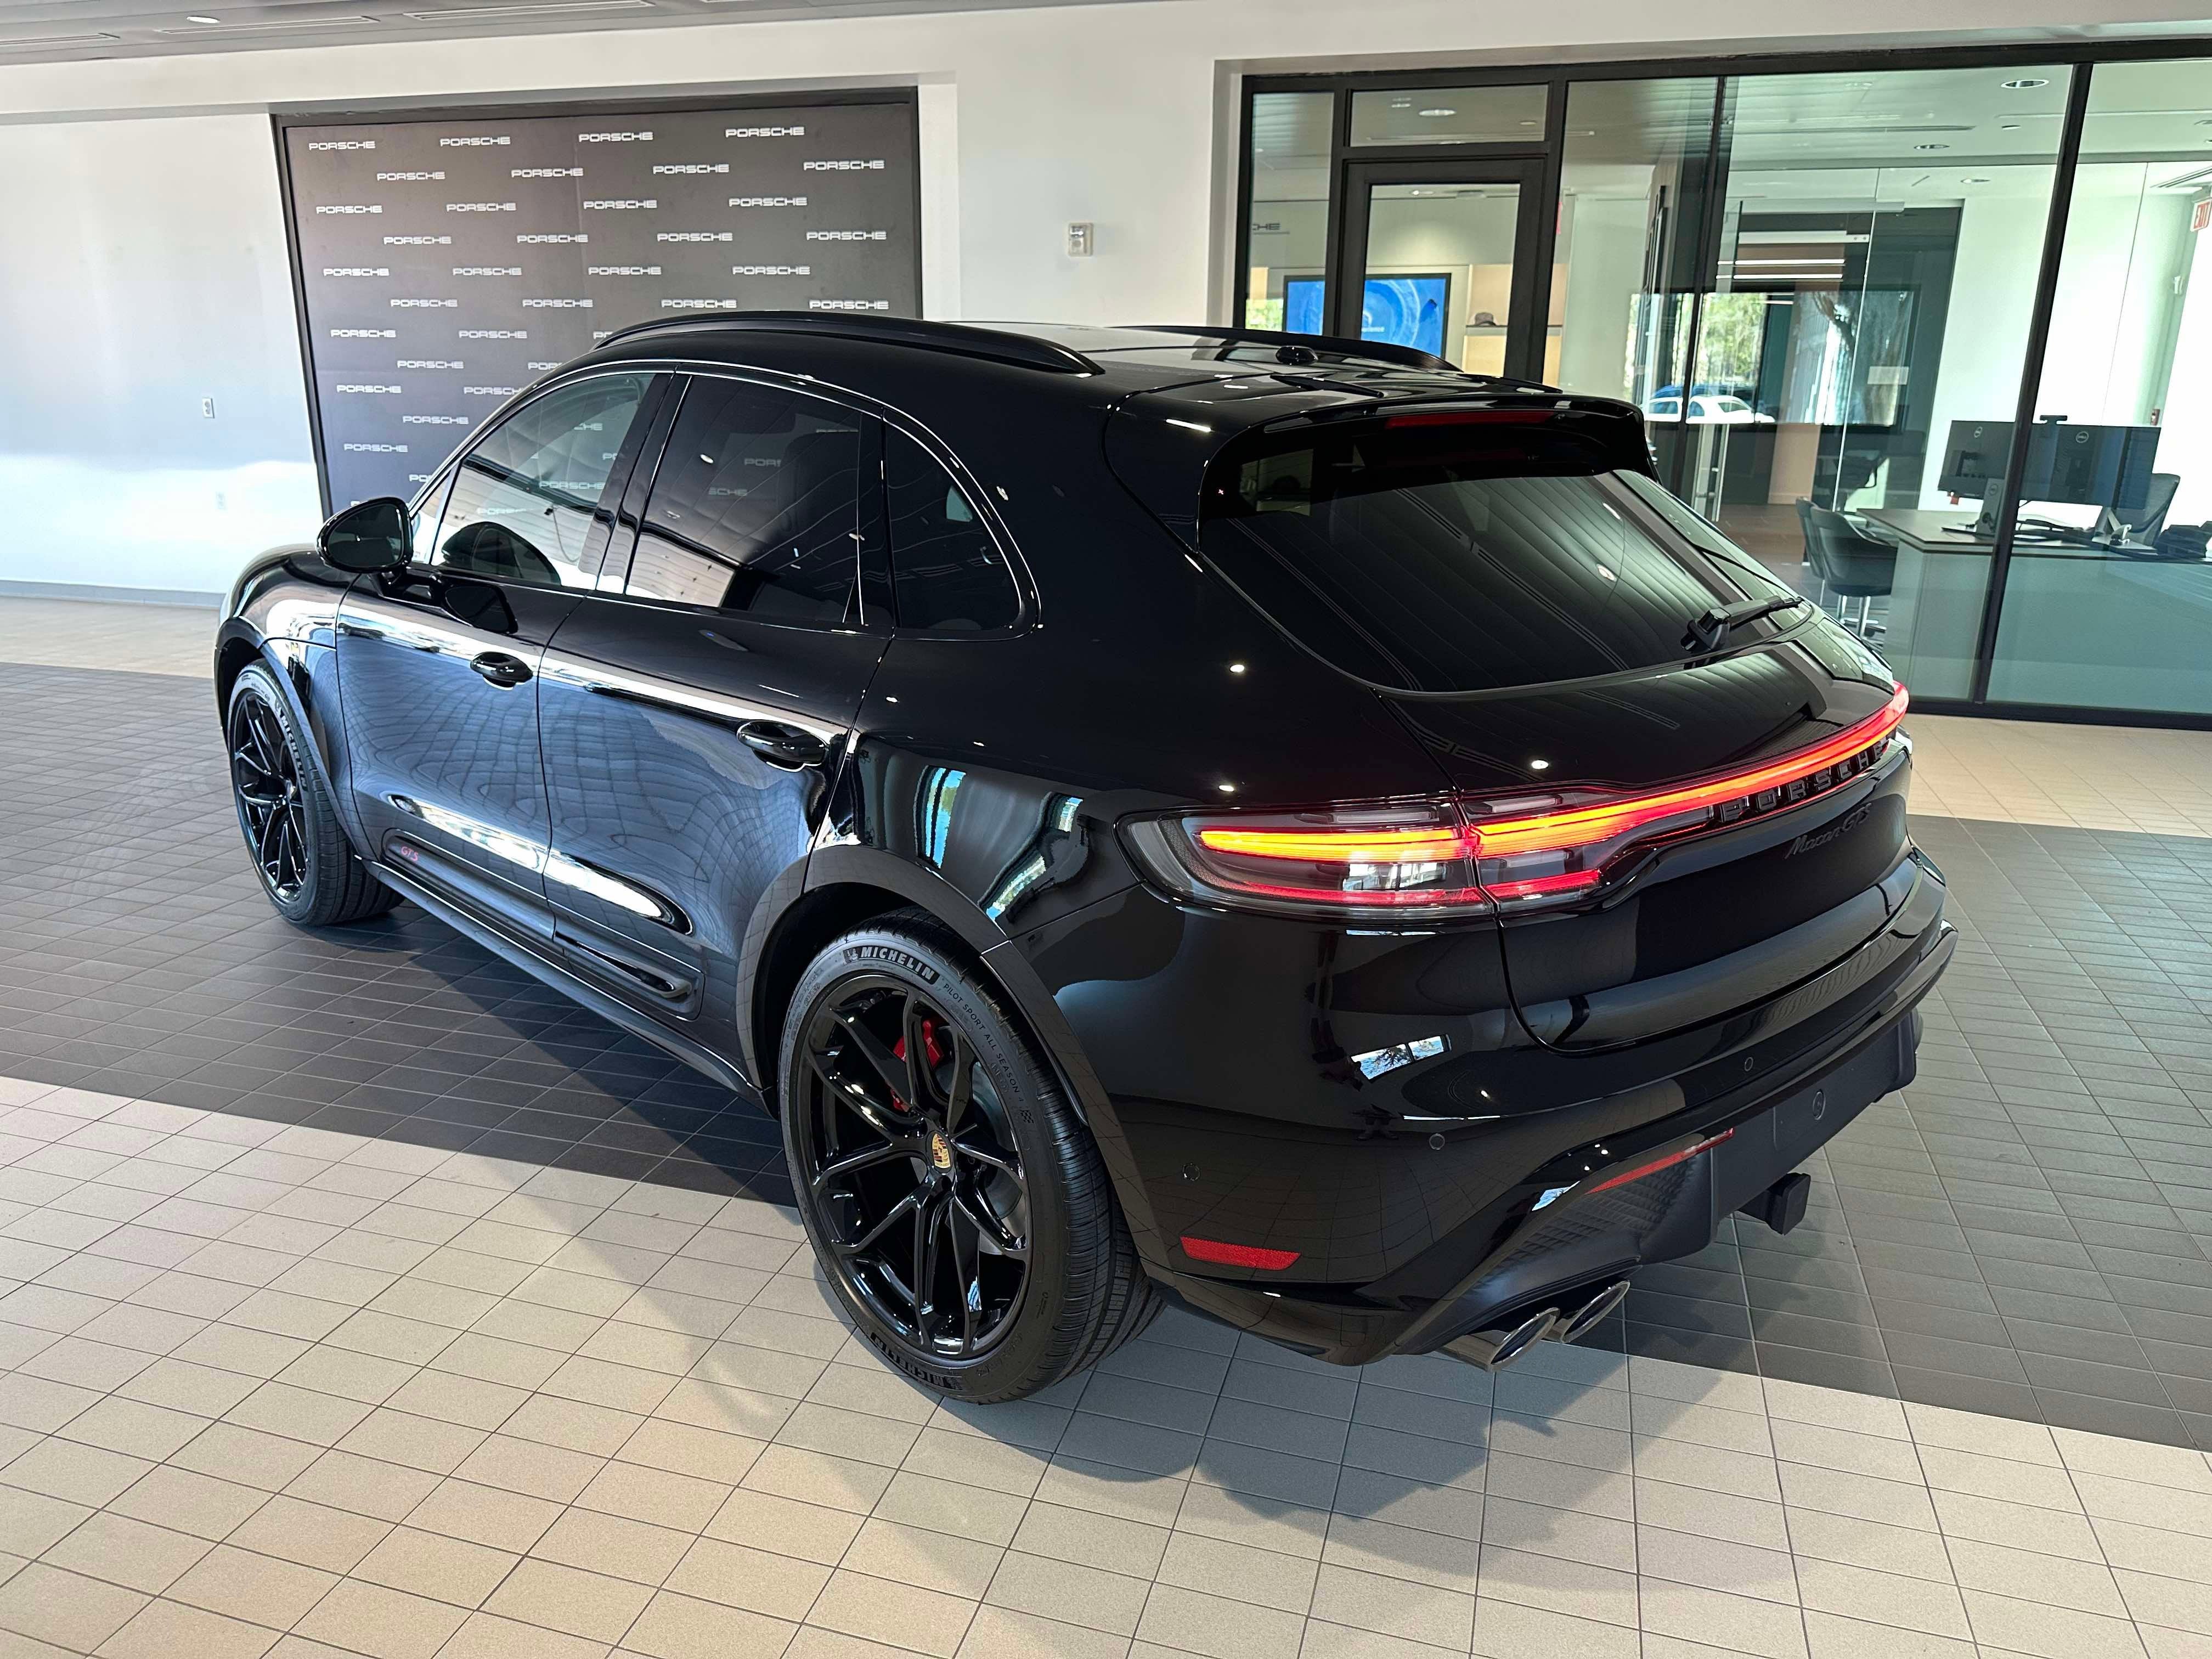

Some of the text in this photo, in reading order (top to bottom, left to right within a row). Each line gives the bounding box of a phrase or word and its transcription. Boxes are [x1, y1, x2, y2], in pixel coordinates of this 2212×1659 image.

[578, 132, 653, 143] PORSCHE
[725, 127, 805, 138] PORSCHE
[308, 140, 376, 151] PORSCHE
[439, 136, 511, 147] PORSCHE
[653, 164, 730, 174] PORSCHE
[803, 160, 885, 171] PORSCHE
[376, 171, 445, 181] PORSCHE
[511, 168, 584, 178] PORSCHE
[446, 202, 516, 212] PORSCHE
[583, 200, 657, 210] PORSCHE
[729, 197, 808, 207] PORSCHE
[315, 205, 382, 214] PORSCHE
[383, 236, 452, 245] PORSCHE
[516, 234, 588, 244] PORSCHE
[657, 232, 733, 242] PORSCHE
[806, 231, 887, 241] PORSCHE
[323, 268, 390, 276] PORSCHE
[452, 267, 522, 276] PORSCHE
[588, 267, 662, 275] PORSCHE
[732, 266, 810, 275] PORSCHE
[390, 299, 458, 307] PORSCHE
[522, 299, 593, 308] PORSCHE
[661, 300, 737, 308] PORSCHE
[809, 300, 889, 309] PORSCHE
[330, 329, 396, 338] PORSCHE
[458, 330, 528, 339] PORSCHE
[397, 360, 464, 369] PORSCHE
[336, 385, 402, 393] PORSCHE
[464, 386, 522, 396] PORSCH
[402, 415, 470, 425] PORSCHE
[343, 443, 408, 453] PORSCHE
[281, 715, 308, 788] MICHELIN
[1719, 741, 1883, 823] PORSCHE
[1784, 802, 1874, 860] Macan GTS
[400, 845, 419, 862] GTS
[860, 946, 936, 981] MICHELIN
[943, 983, 964, 1003] PILOT
[962, 1004, 986, 1030] SPORT
[983, 1034, 996, 1051] ALL
[996, 1053, 1020, 1093] SEASON
